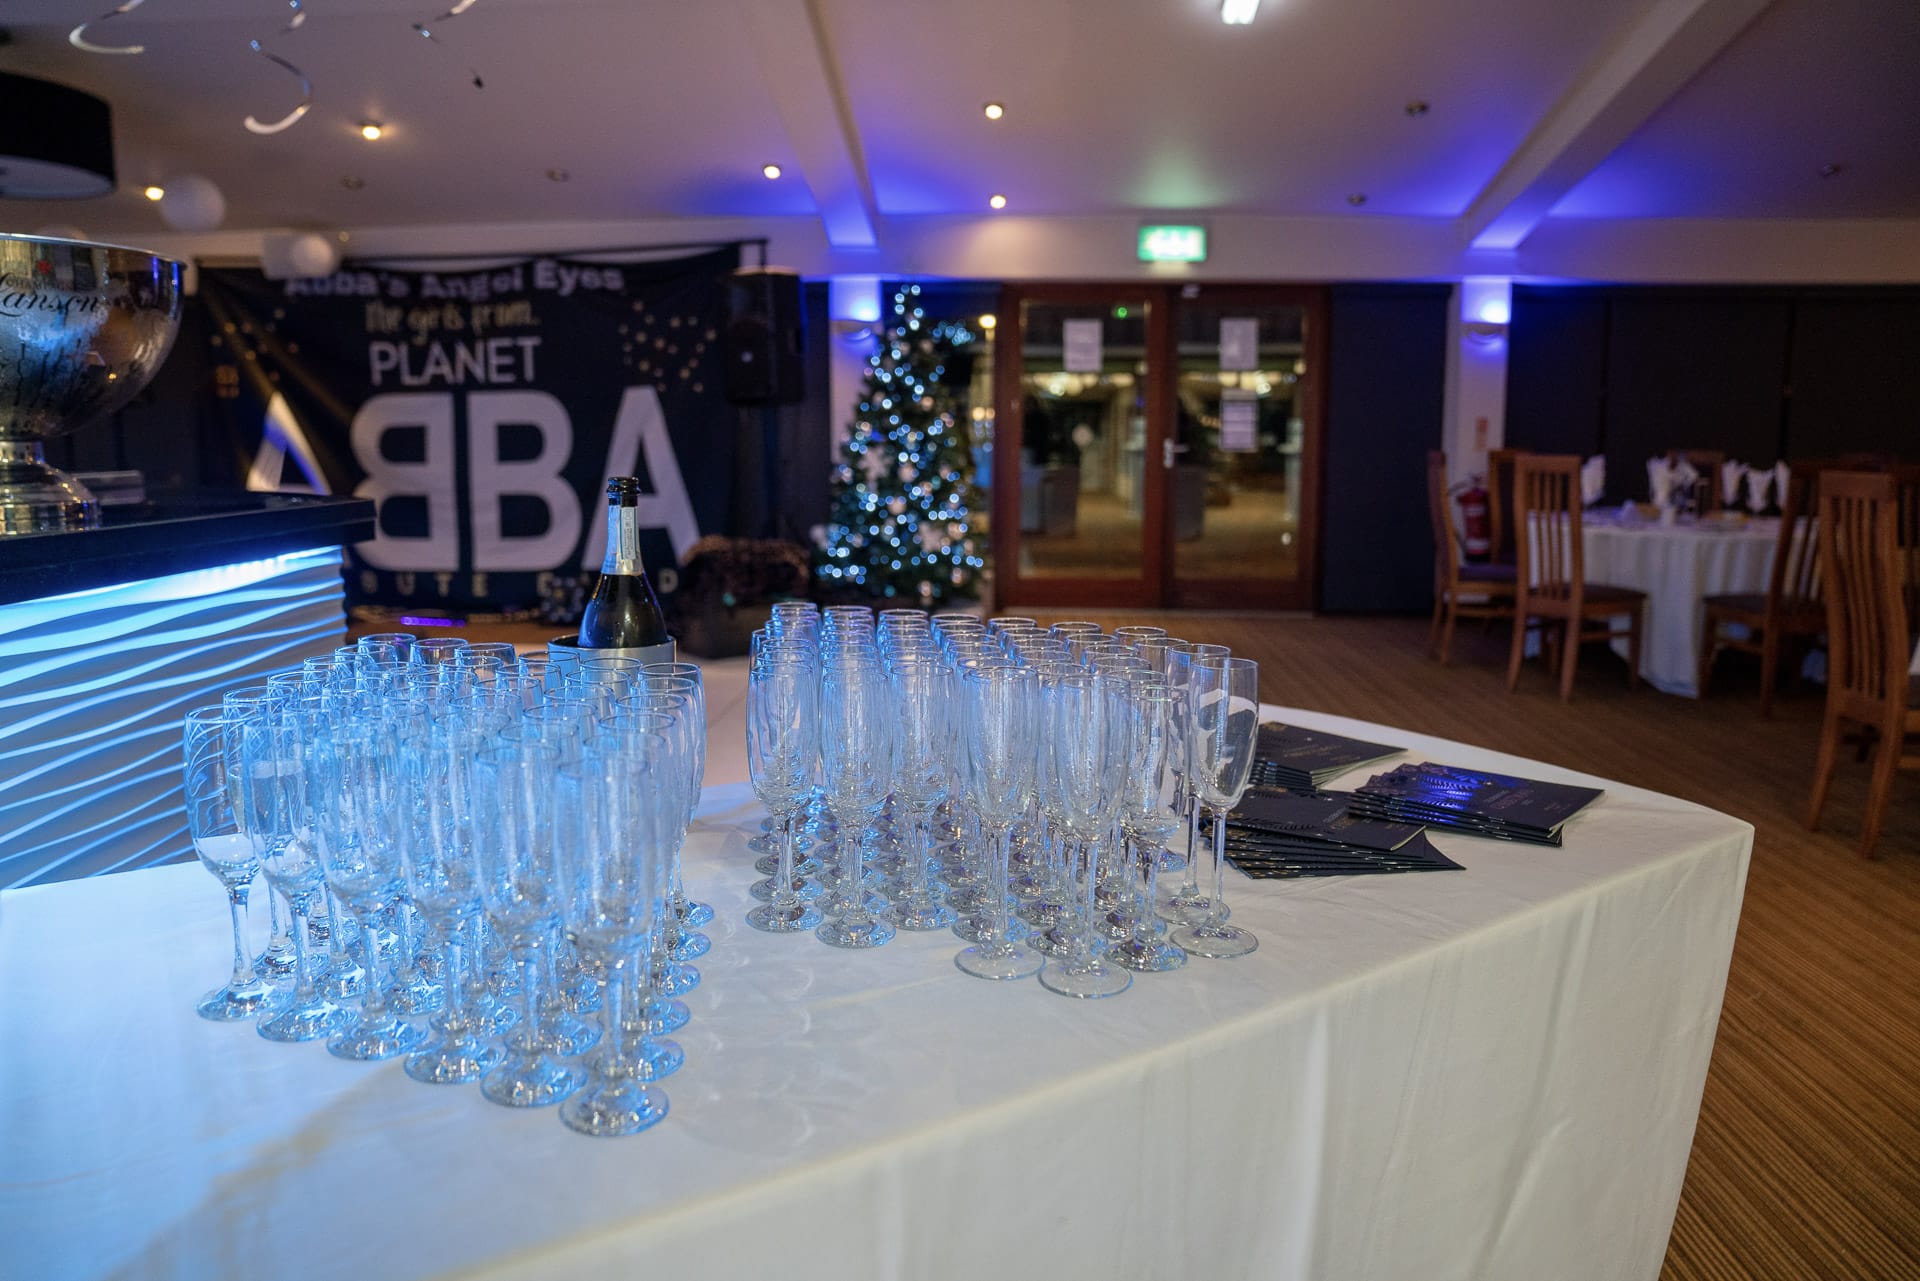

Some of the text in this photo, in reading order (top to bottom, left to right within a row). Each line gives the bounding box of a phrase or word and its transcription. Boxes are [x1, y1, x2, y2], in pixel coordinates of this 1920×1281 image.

[421, 266, 524, 301] Angel
[533, 257, 625, 296] Eyes
[368, 335, 543, 386] PLANET
